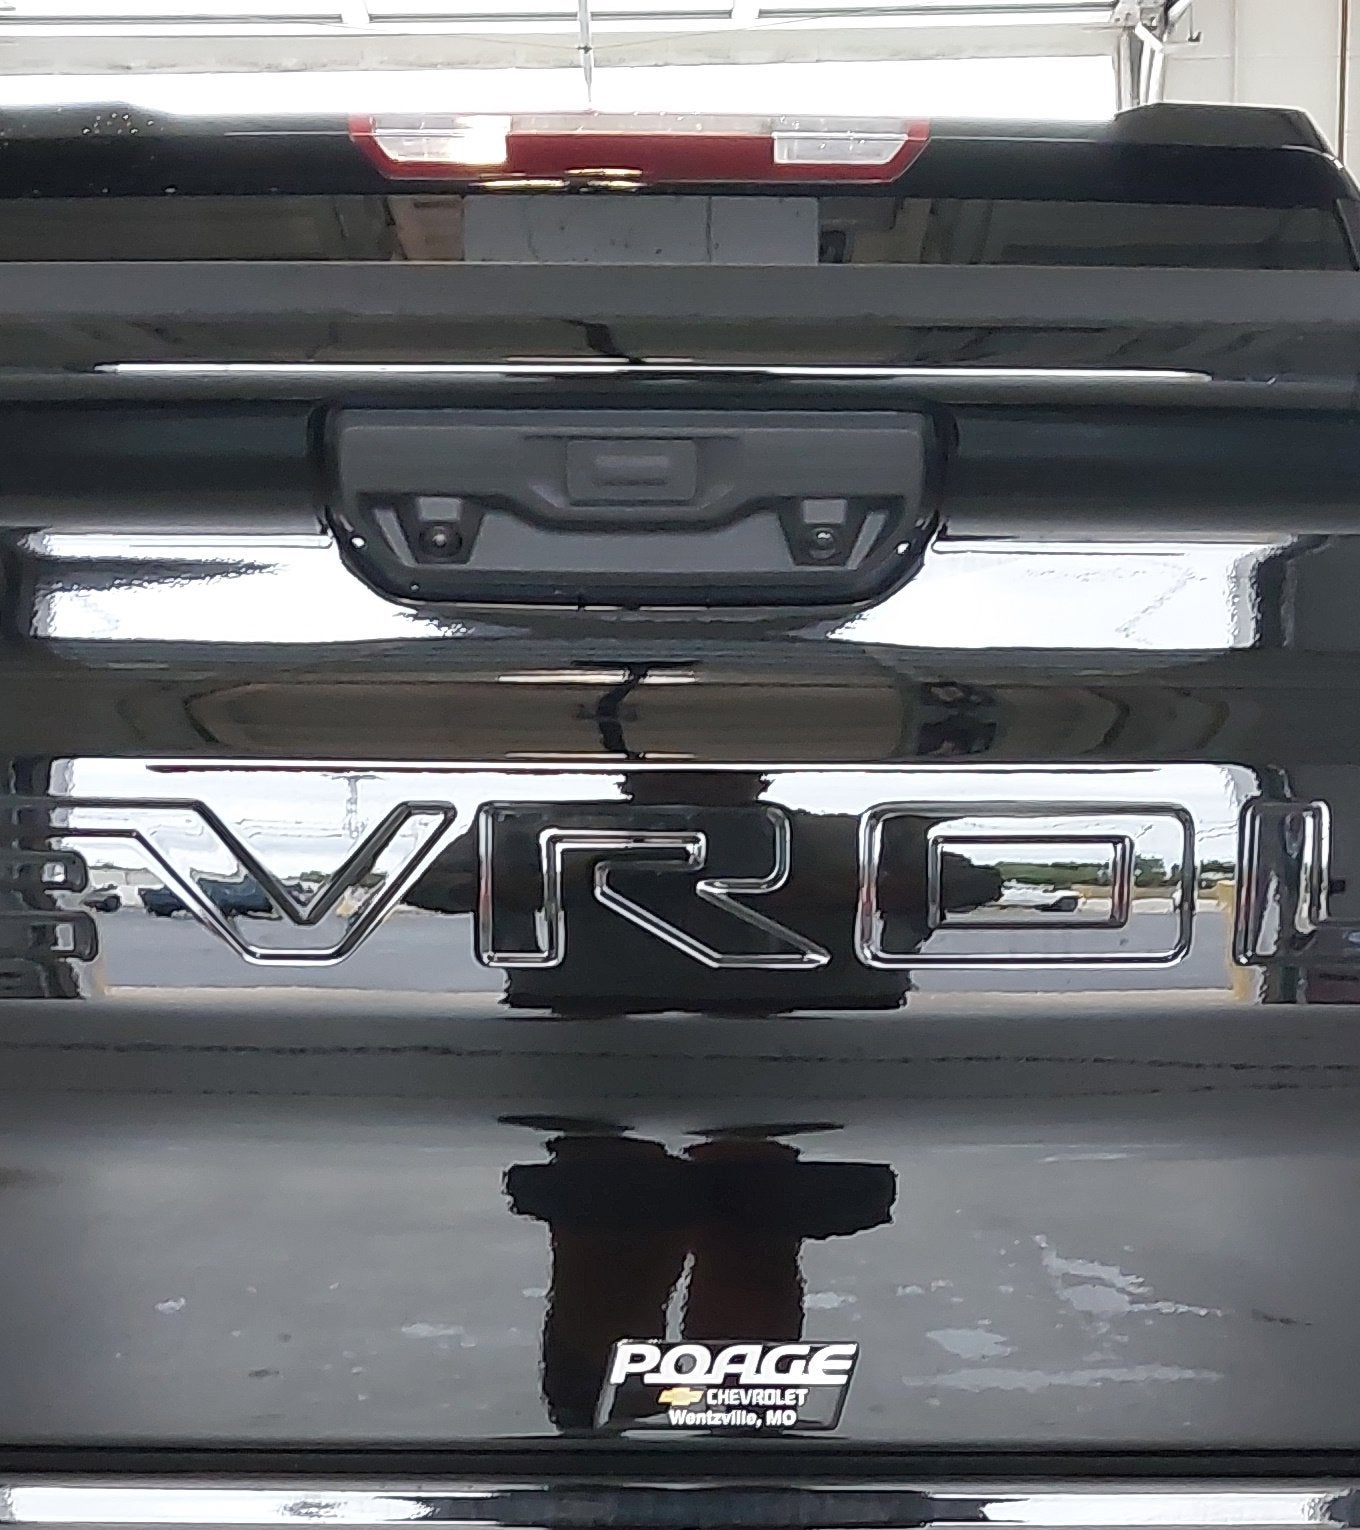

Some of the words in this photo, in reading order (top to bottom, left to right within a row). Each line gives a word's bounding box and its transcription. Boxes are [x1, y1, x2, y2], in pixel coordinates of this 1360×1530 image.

[609, 1343, 858, 1385] POAGE
[705, 1387, 809, 1406] CHEVROLET
[668, 1409, 763, 1428] Wentzville,
[765, 1410, 797, 1426] MO
